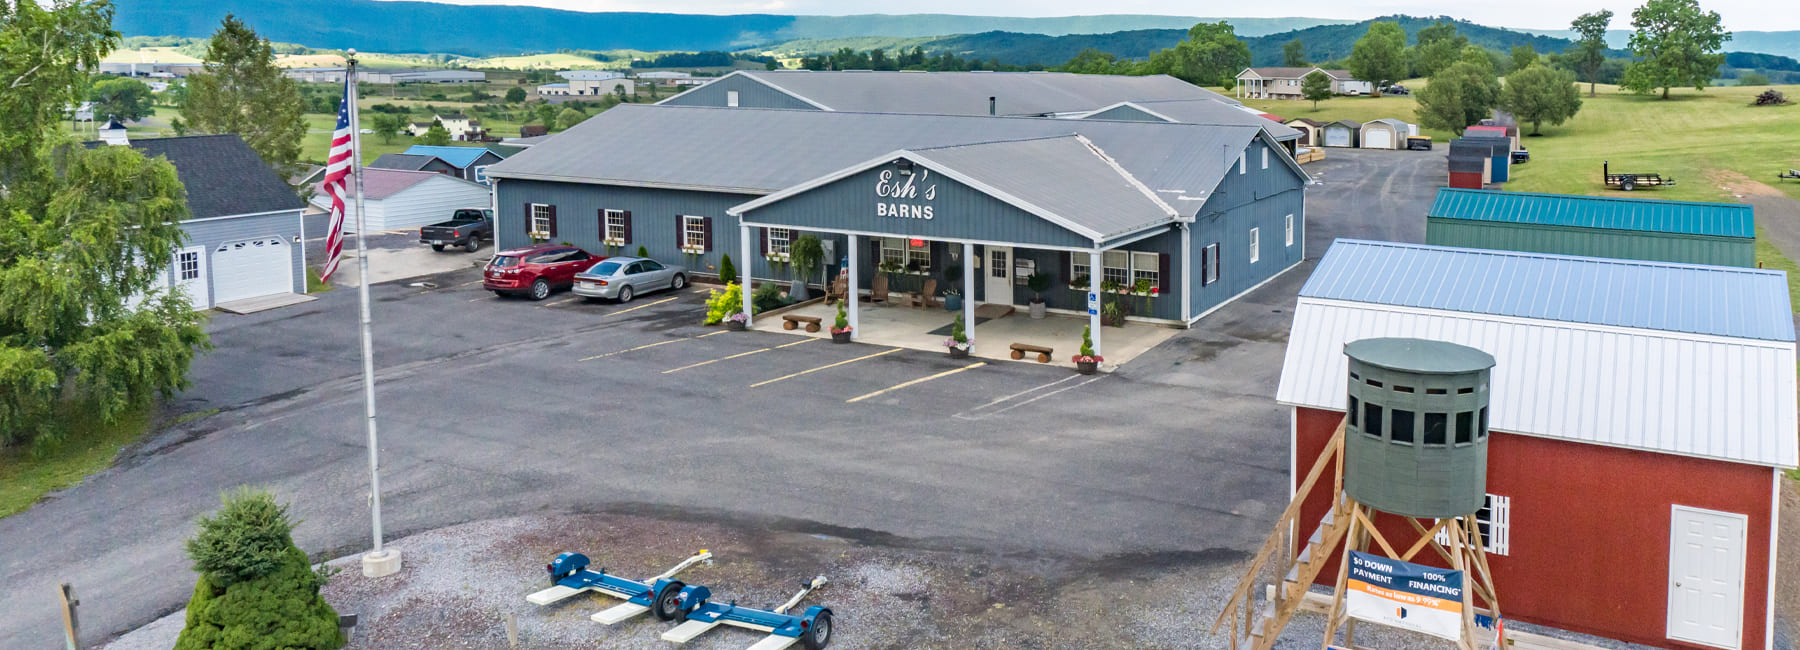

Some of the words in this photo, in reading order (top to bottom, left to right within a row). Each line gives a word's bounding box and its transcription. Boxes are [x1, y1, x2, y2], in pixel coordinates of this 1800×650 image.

[876, 169, 936, 200] Esh's
[877, 203, 934, 219] BARNS
[1353, 557, 1363, 566] $0
[1364, 559, 1392, 573] DOWN
[1353, 567, 1392, 584] PAYMENT
[1422, 572, 1446, 582] 100%
